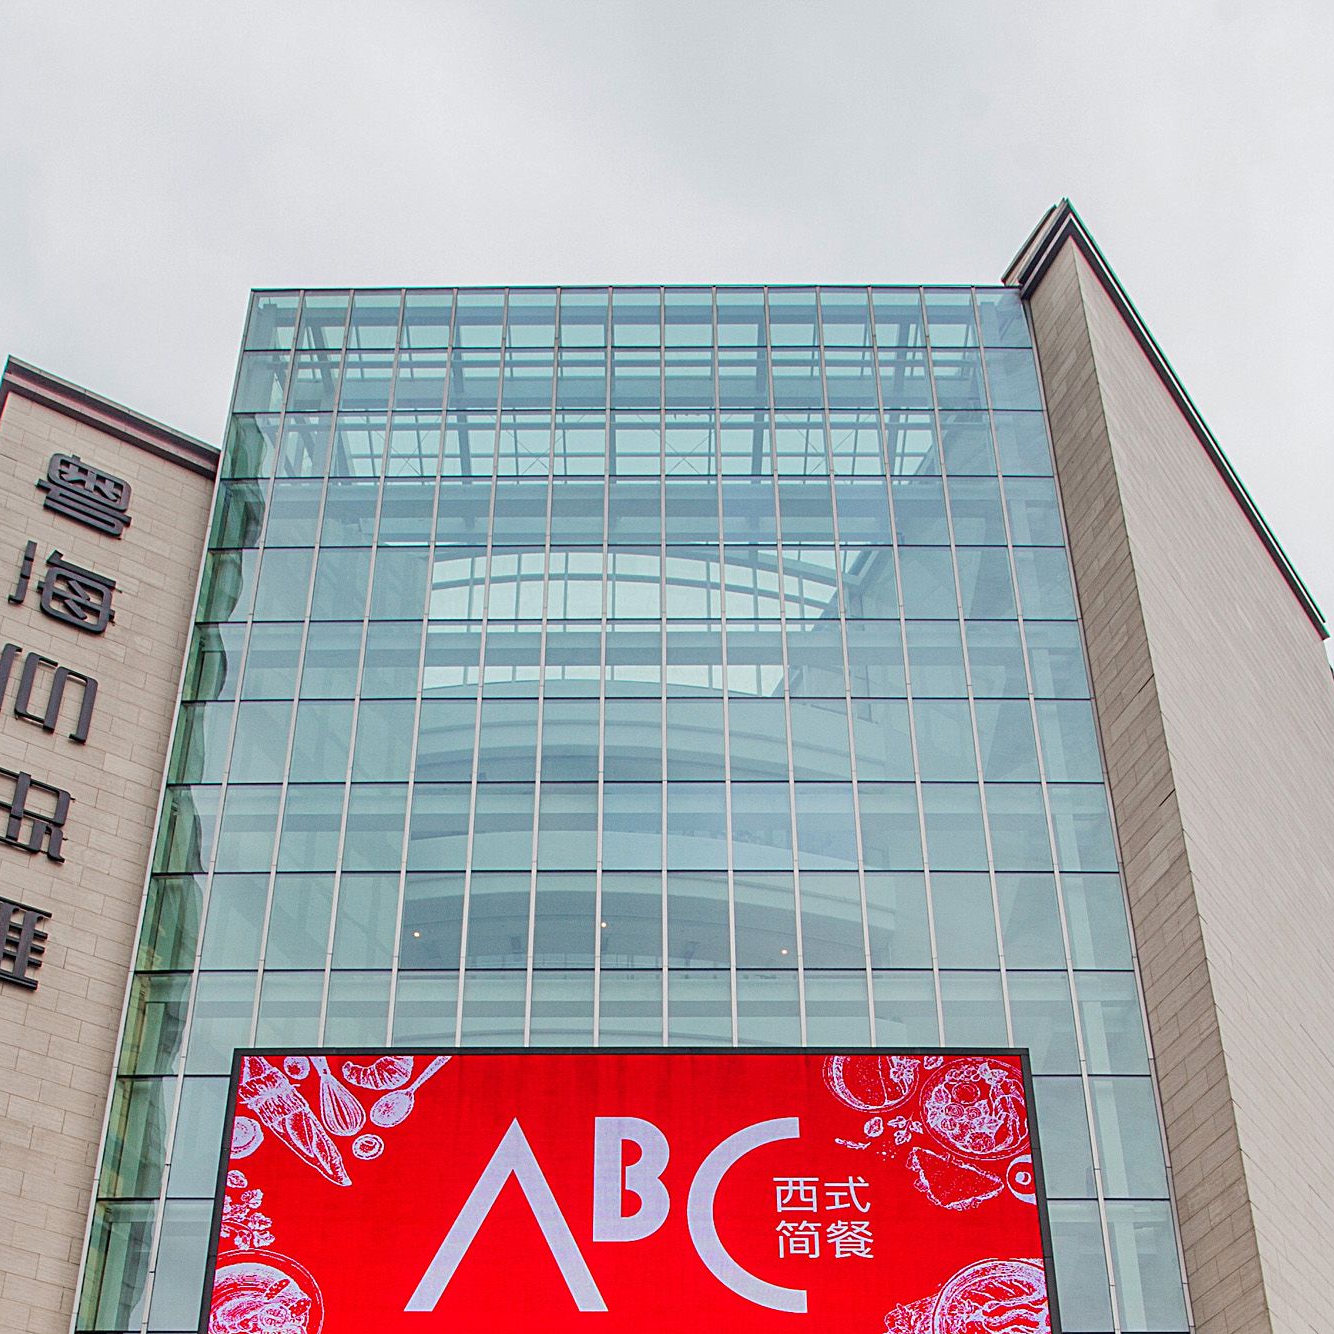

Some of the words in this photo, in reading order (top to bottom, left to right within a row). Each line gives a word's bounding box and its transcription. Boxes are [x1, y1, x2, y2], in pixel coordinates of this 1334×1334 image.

[404, 1116, 808, 1313] ABC
[773, 1176, 872, 1213] 西式
[775, 1220, 875, 1260] 简餐
